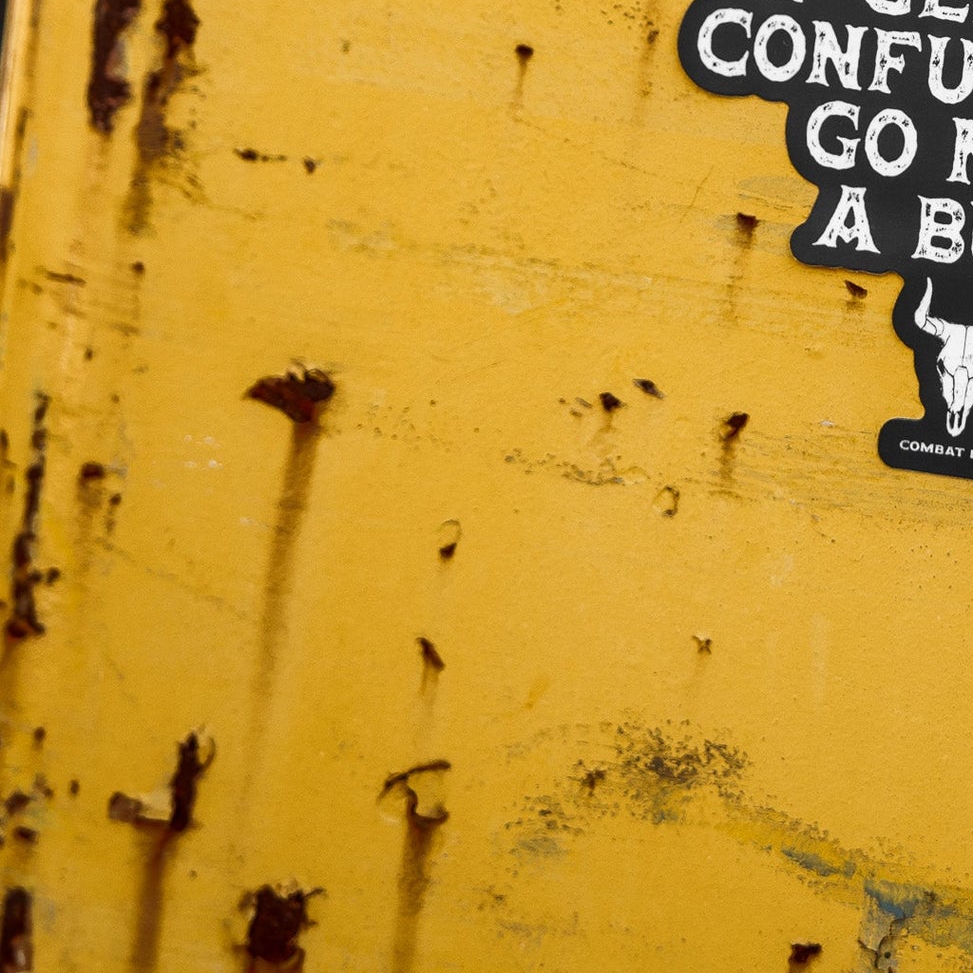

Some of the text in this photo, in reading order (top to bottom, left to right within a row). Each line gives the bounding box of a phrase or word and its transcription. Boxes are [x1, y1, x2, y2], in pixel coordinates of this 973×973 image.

[807, 101, 917, 176] GO
[812, 185, 880, 254] A
[899, 439, 965, 458] COMBAT
